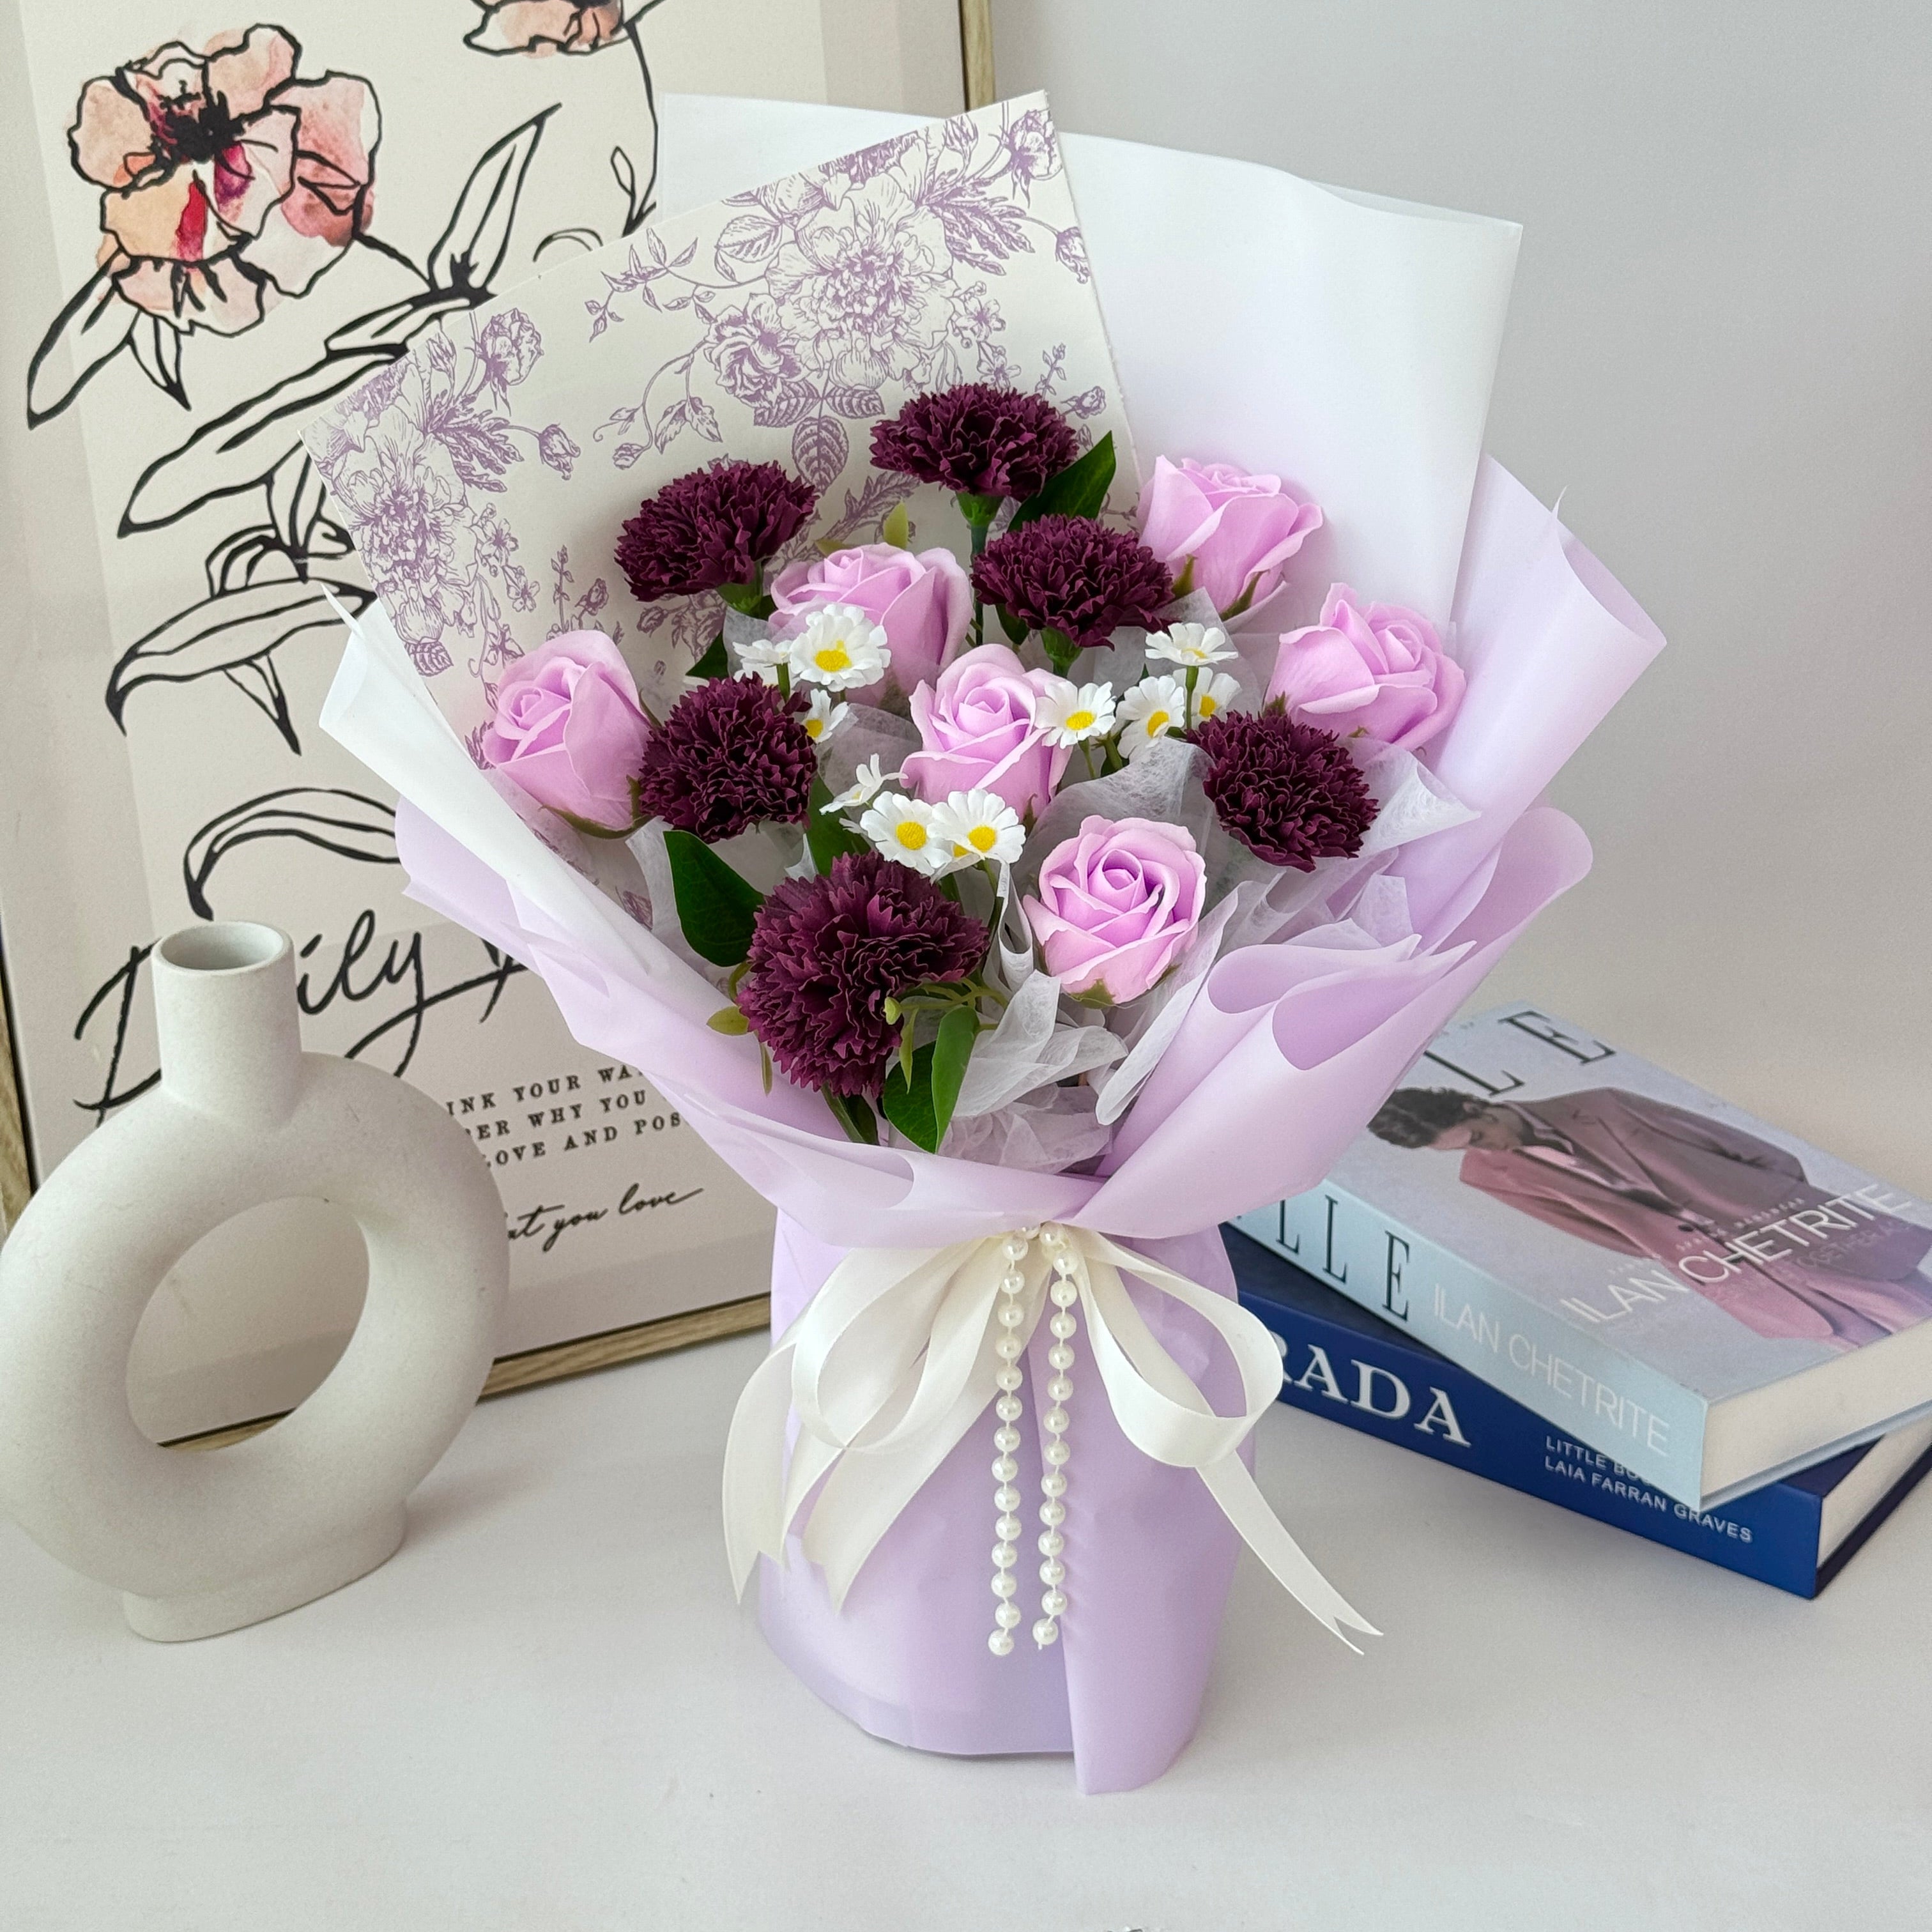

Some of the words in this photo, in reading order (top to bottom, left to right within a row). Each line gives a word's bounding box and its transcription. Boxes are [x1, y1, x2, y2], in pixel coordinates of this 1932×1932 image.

[465, 1120, 510, 1140] ER
[528, 1103, 582, 1128] WHY
[599, 1089, 646, 1113] YOU
[512, 1075, 581, 1102] YOUR
[597, 1064, 643, 1083] WA
[482, 1142, 546, 1169] OVE
[564, 1126, 618, 1151] AND
[635, 1112, 682, 1136] POS
[543, 1208, 609, 1253] you
[618, 1183, 705, 1216] love
[1560, 1269, 1690, 1323] ILAN
[1678, 1184, 1913, 1284] CHETRITE
[1237, 1194, 1410, 1322] LLE
[1434, 1283, 1500, 1354] ILAN
[1508, 1333, 1670, 1458] CHETRITE
[1545, 1435, 1607, 1469] LITTLE
[1545, 1455, 1586, 1483] LAIA
[1591, 1472, 1667, 1513] FARRAN
[1673, 1503, 1754, 1544] GRAVES
